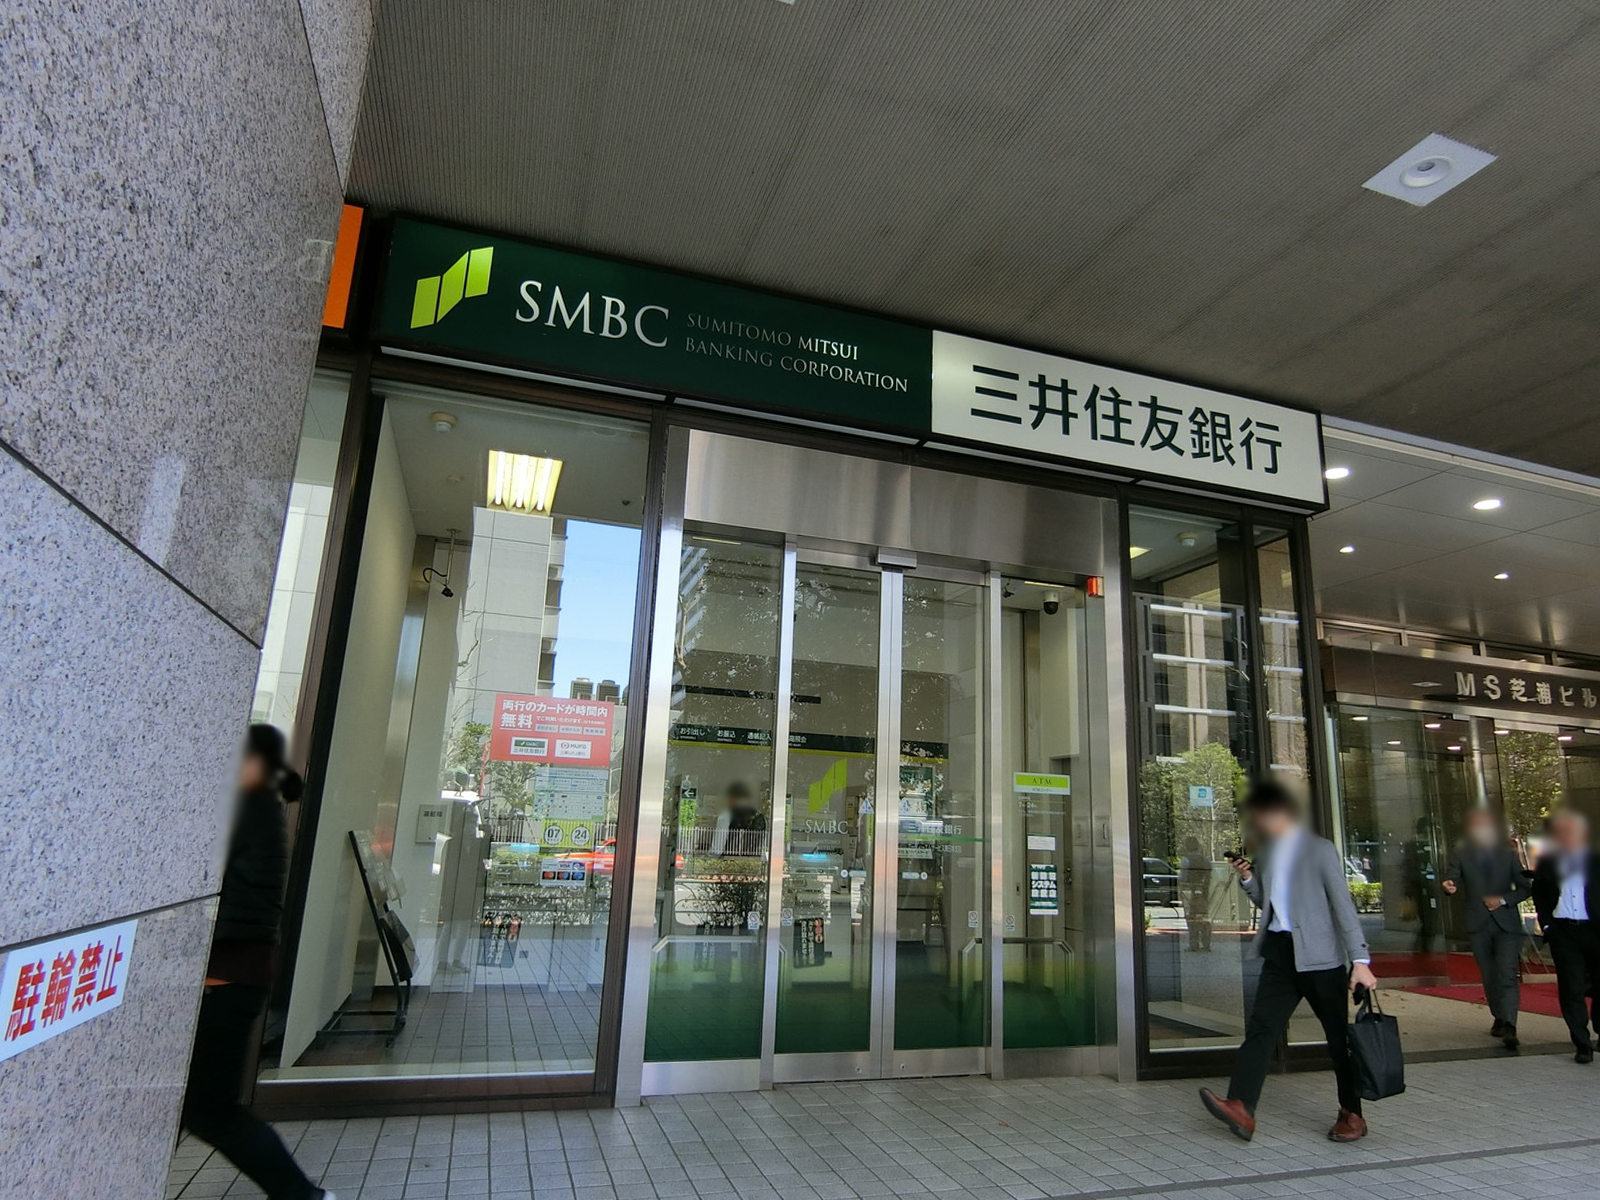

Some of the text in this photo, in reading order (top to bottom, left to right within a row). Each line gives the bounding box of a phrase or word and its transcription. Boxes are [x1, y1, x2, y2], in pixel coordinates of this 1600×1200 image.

[515, 280, 670, 348] SMBC
[687, 312, 859, 361] SUMITOMO MITSUI
[685, 337, 909, 394] BANKING CORPORATION
[970, 364, 1282, 475] 三井住友銀行
[501, 712, 533, 729] 無料
[502, 699, 608, 717] 両行のカードが時間内
[547, 828, 587, 840] 07 24
[805, 819, 849, 834] SMBC
[1031, 880, 1056, 889] システム
[4, 935, 123, 1041] 駐輪禁止
